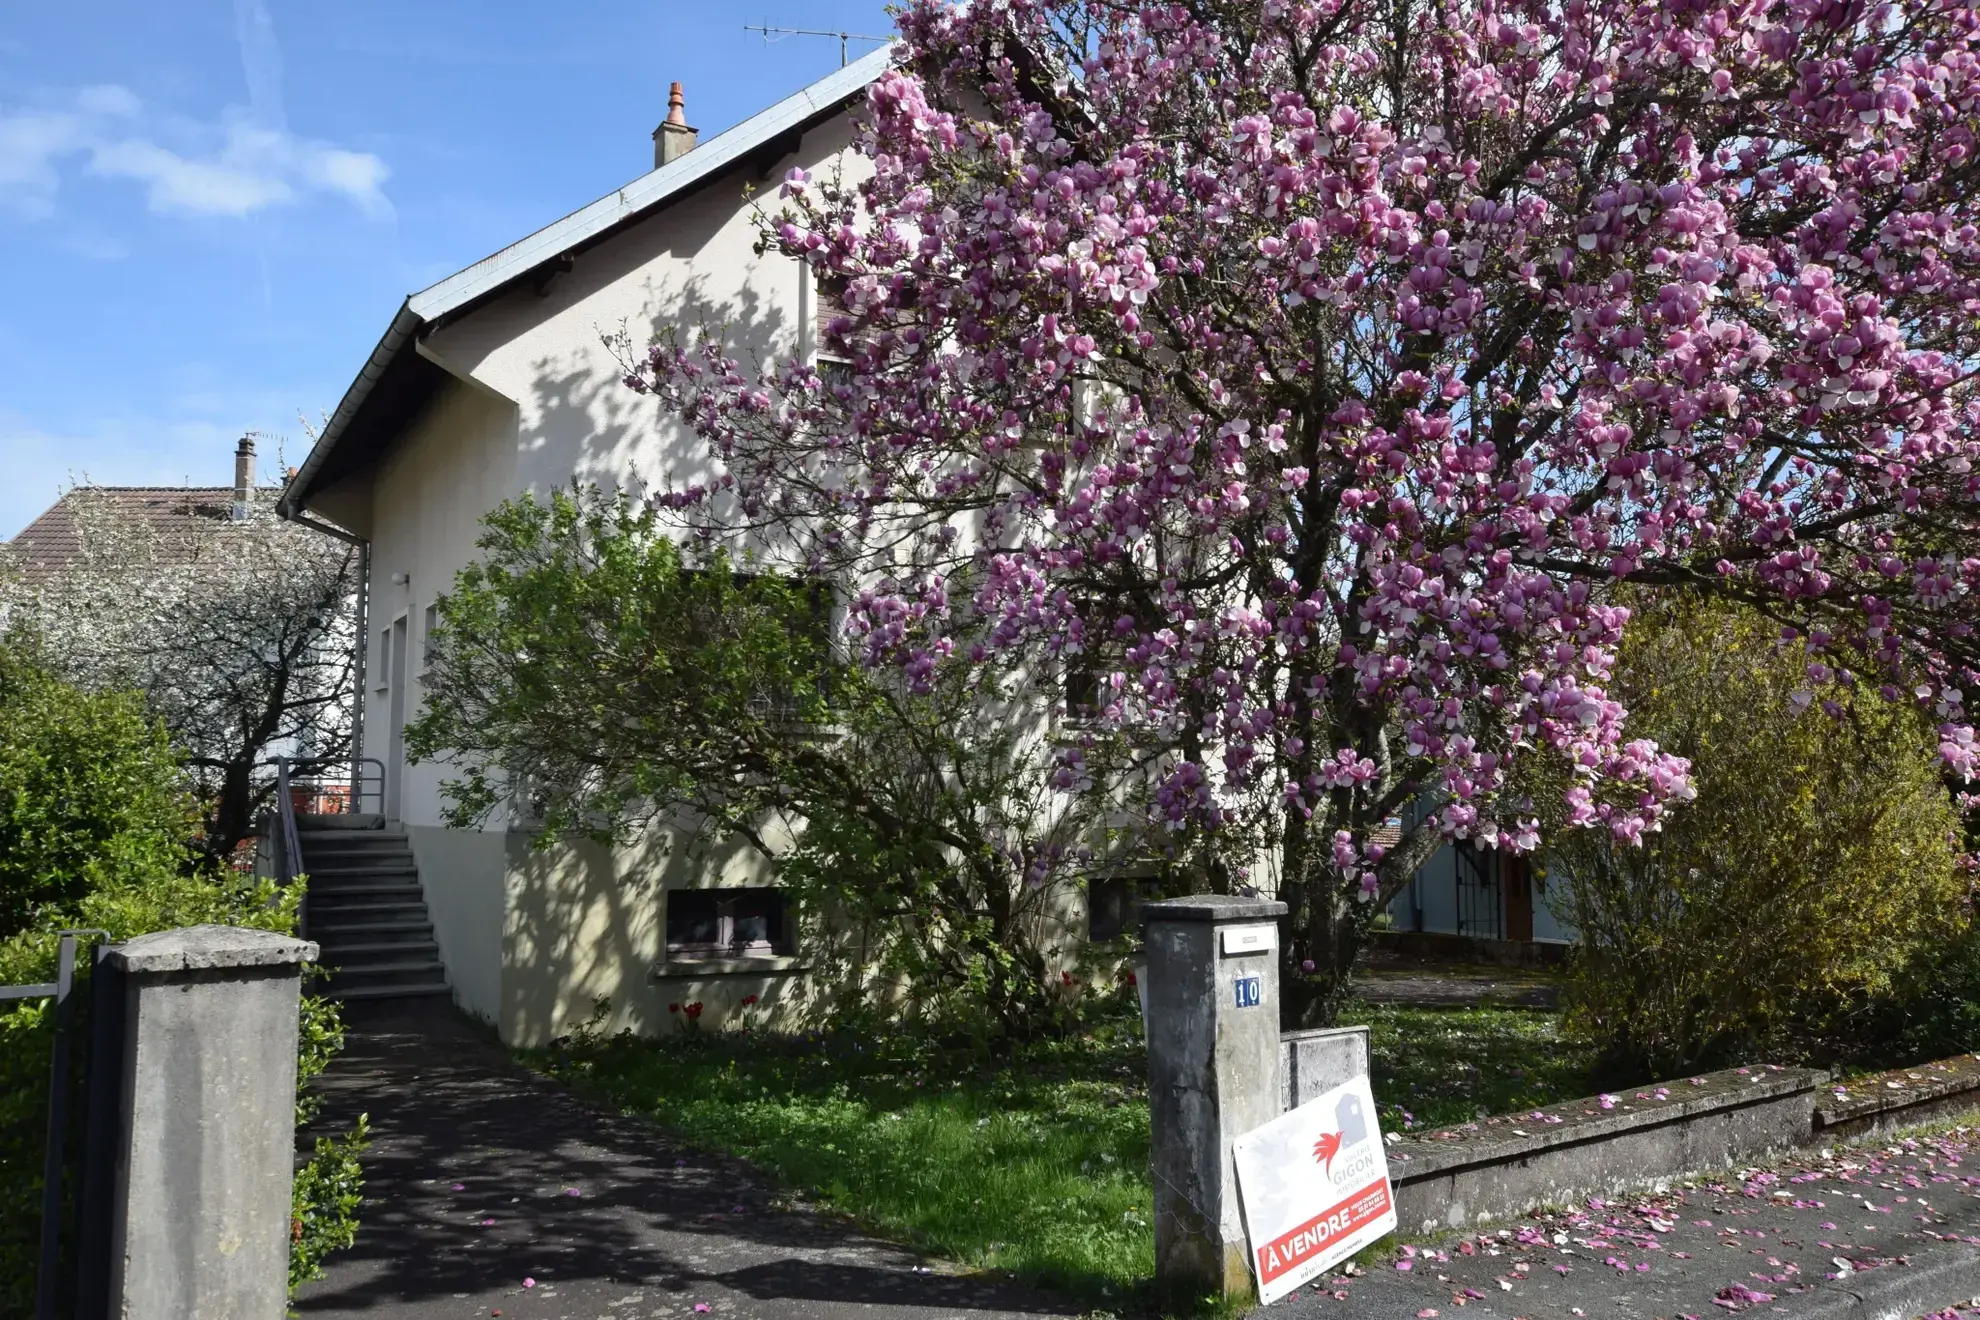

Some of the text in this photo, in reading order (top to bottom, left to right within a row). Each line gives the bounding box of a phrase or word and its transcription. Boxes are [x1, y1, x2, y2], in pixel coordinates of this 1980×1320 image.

[1238, 981, 1258, 1003] 10
[1333, 1154, 1374, 1185] GIGON
[1280, 1208, 1352, 1262] VENDRE
